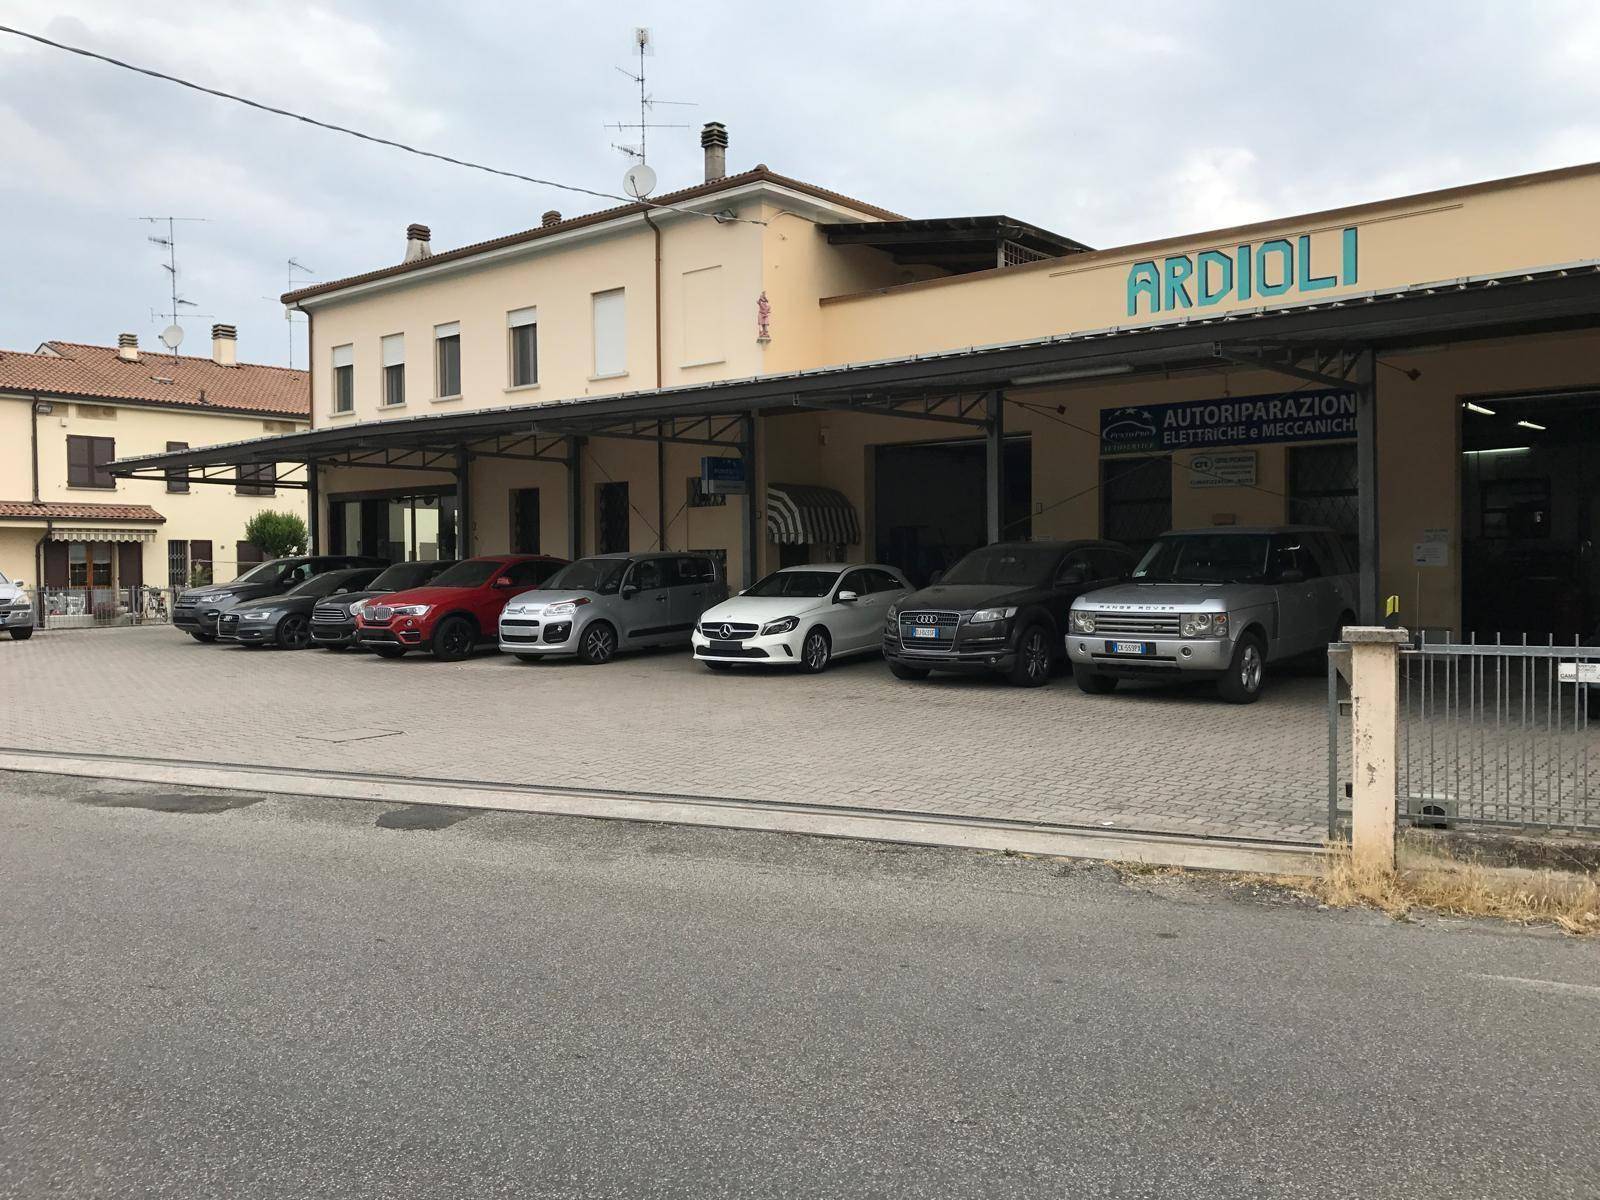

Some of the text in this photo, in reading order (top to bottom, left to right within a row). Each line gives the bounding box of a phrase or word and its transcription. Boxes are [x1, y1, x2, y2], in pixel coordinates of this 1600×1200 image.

[1127, 226, 1358, 317] ARDIOLI
[1163, 395, 1356, 428] AUTORIPARAZION
[1250, 428, 1259, 438] e
[1262, 417, 1357, 437] MECCANICH
